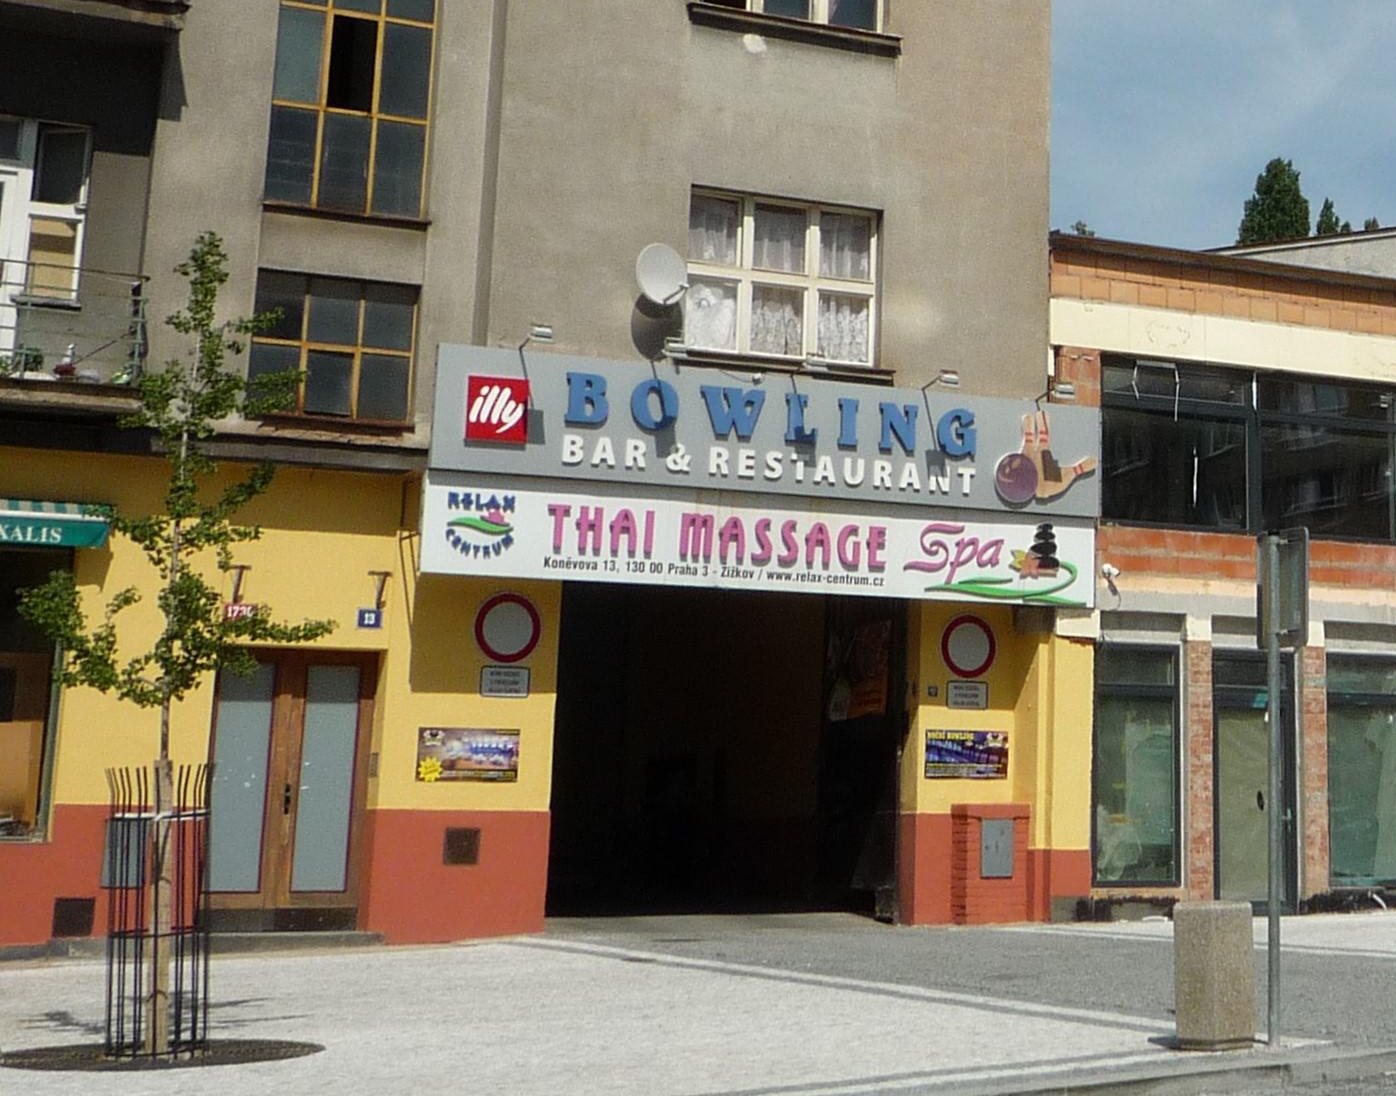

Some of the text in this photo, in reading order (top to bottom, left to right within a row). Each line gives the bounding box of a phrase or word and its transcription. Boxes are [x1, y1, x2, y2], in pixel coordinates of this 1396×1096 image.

[468, 385, 525, 434] illy
[565, 371, 978, 458] BOWLING
[562, 434, 977, 496] BAR & RESTAURANT
[548, 504, 888, 573] THAI MASSAGE
[903, 523, 1004, 585] Spa
[626, 560, 646, 574] 130
[649, 561, 664, 575] 00
[668, 563, 699, 577] Praha
[702, 565, 709, 578] 3
[766, 570, 885, 587] www.relax-centrum.cz
